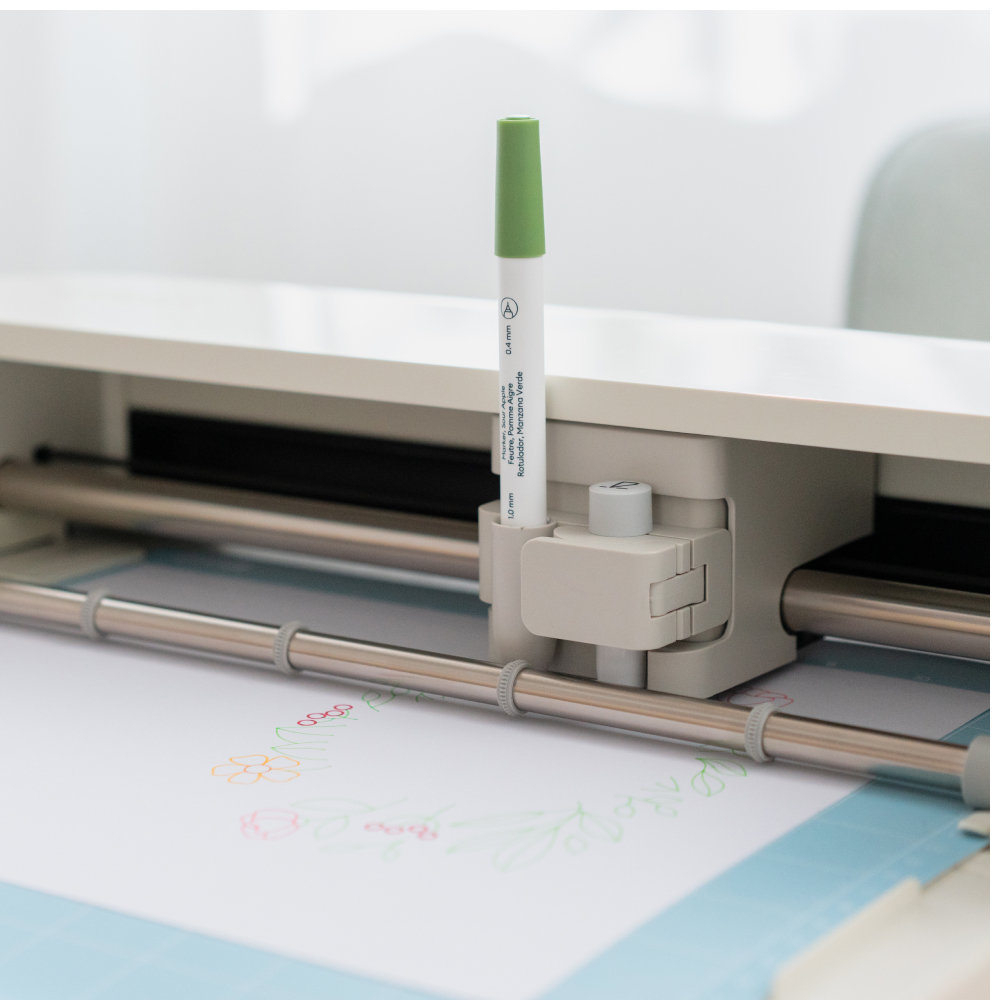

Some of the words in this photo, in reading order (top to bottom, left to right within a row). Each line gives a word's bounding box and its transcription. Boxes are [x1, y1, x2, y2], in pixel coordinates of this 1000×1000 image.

[506, 325, 511, 340] mm
[507, 383, 515, 405] Aigre
[517, 436, 525, 477] Rotulador,
[509, 493, 514, 508] mm
